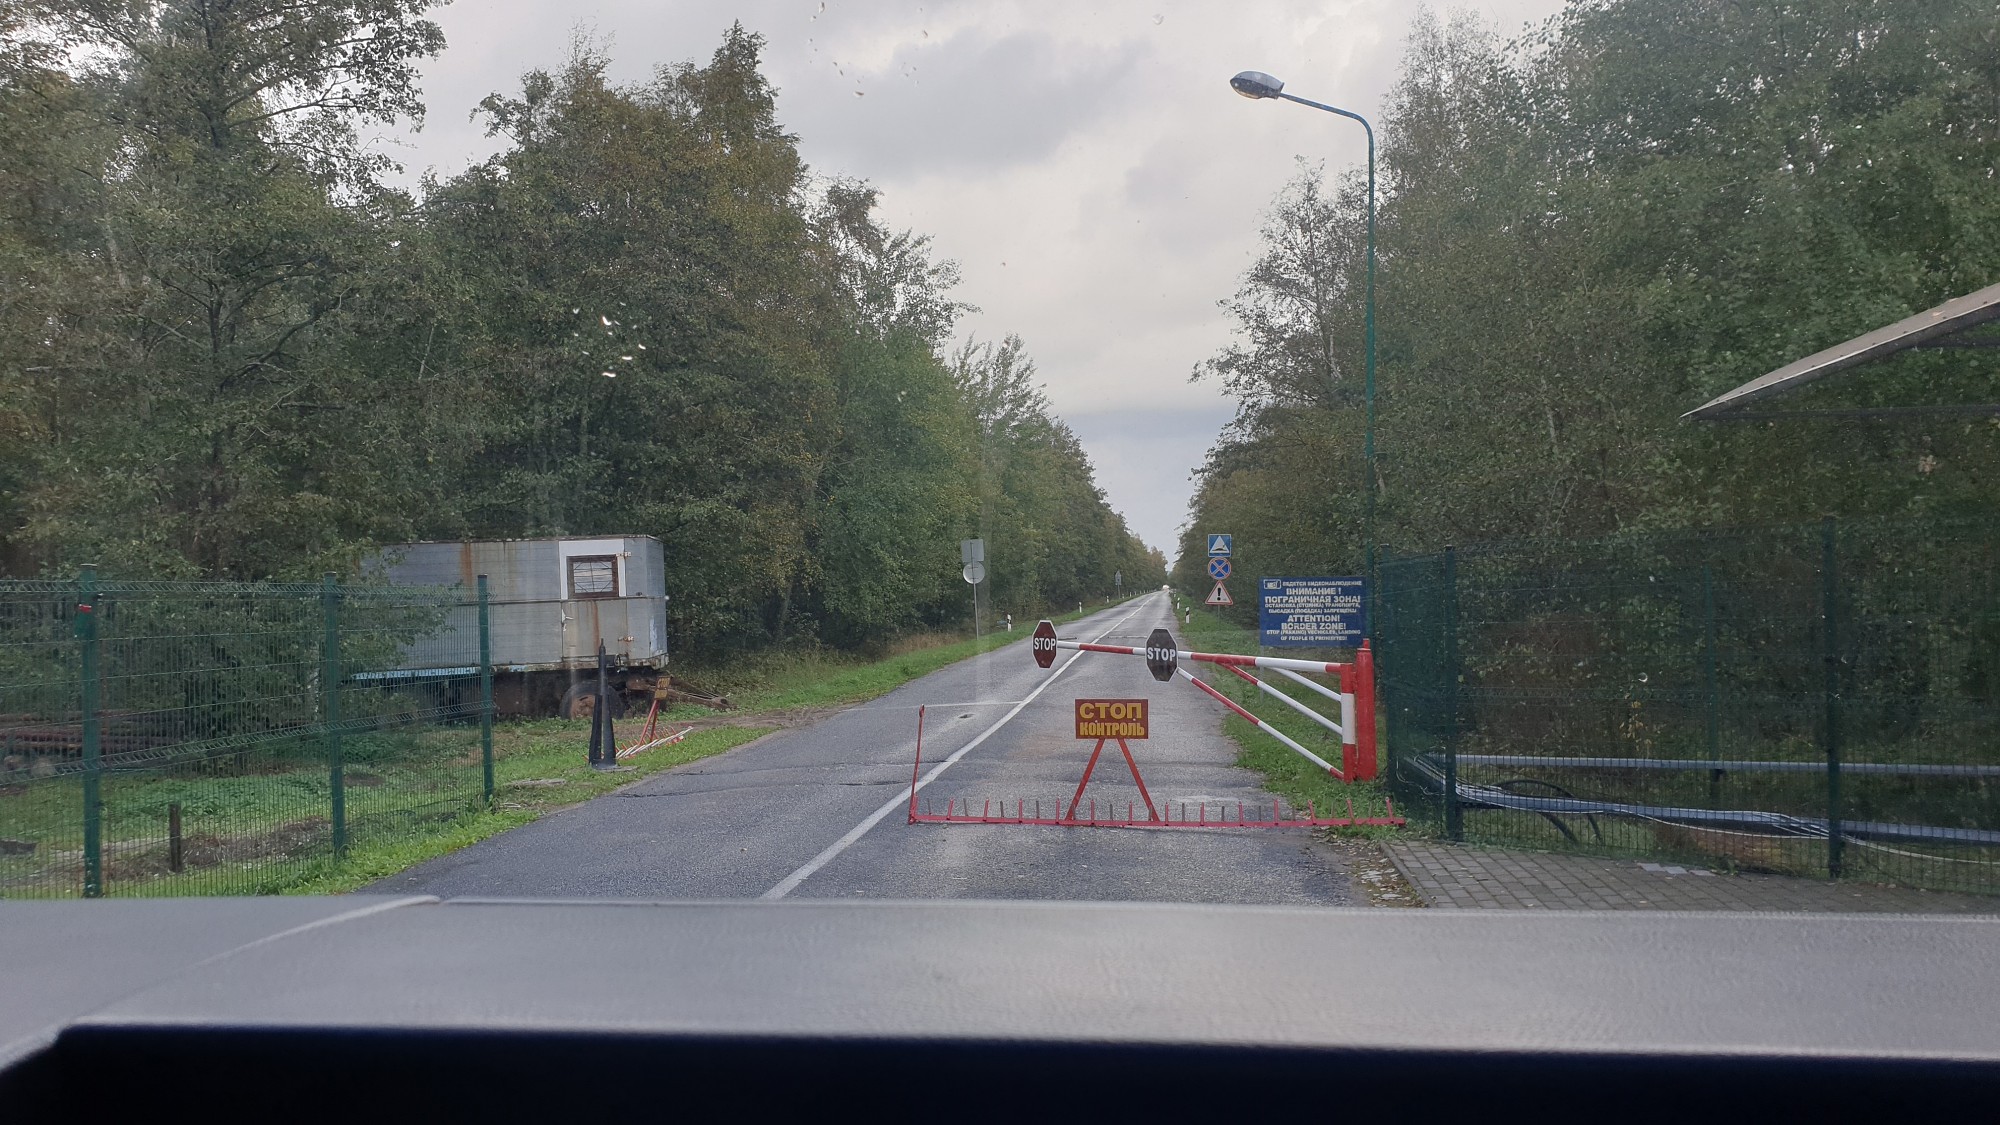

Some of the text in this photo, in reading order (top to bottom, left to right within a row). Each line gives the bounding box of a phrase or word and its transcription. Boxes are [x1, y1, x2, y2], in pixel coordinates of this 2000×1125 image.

[1286, 587, 1336, 595] ВНИМАНИЕ
[1333, 595, 1361, 603] ЗОНА!
[1287, 614, 1340, 622] ATTENTION!
[1281, 622, 1347, 630] BORDER ZONE!
[1033, 637, 1056, 651] STOP
[1147, 647, 1176, 662] STOP
[1079, 702, 1142, 719] СТОП
[1079, 721, 1145, 736] КОНТРОЛЬ
